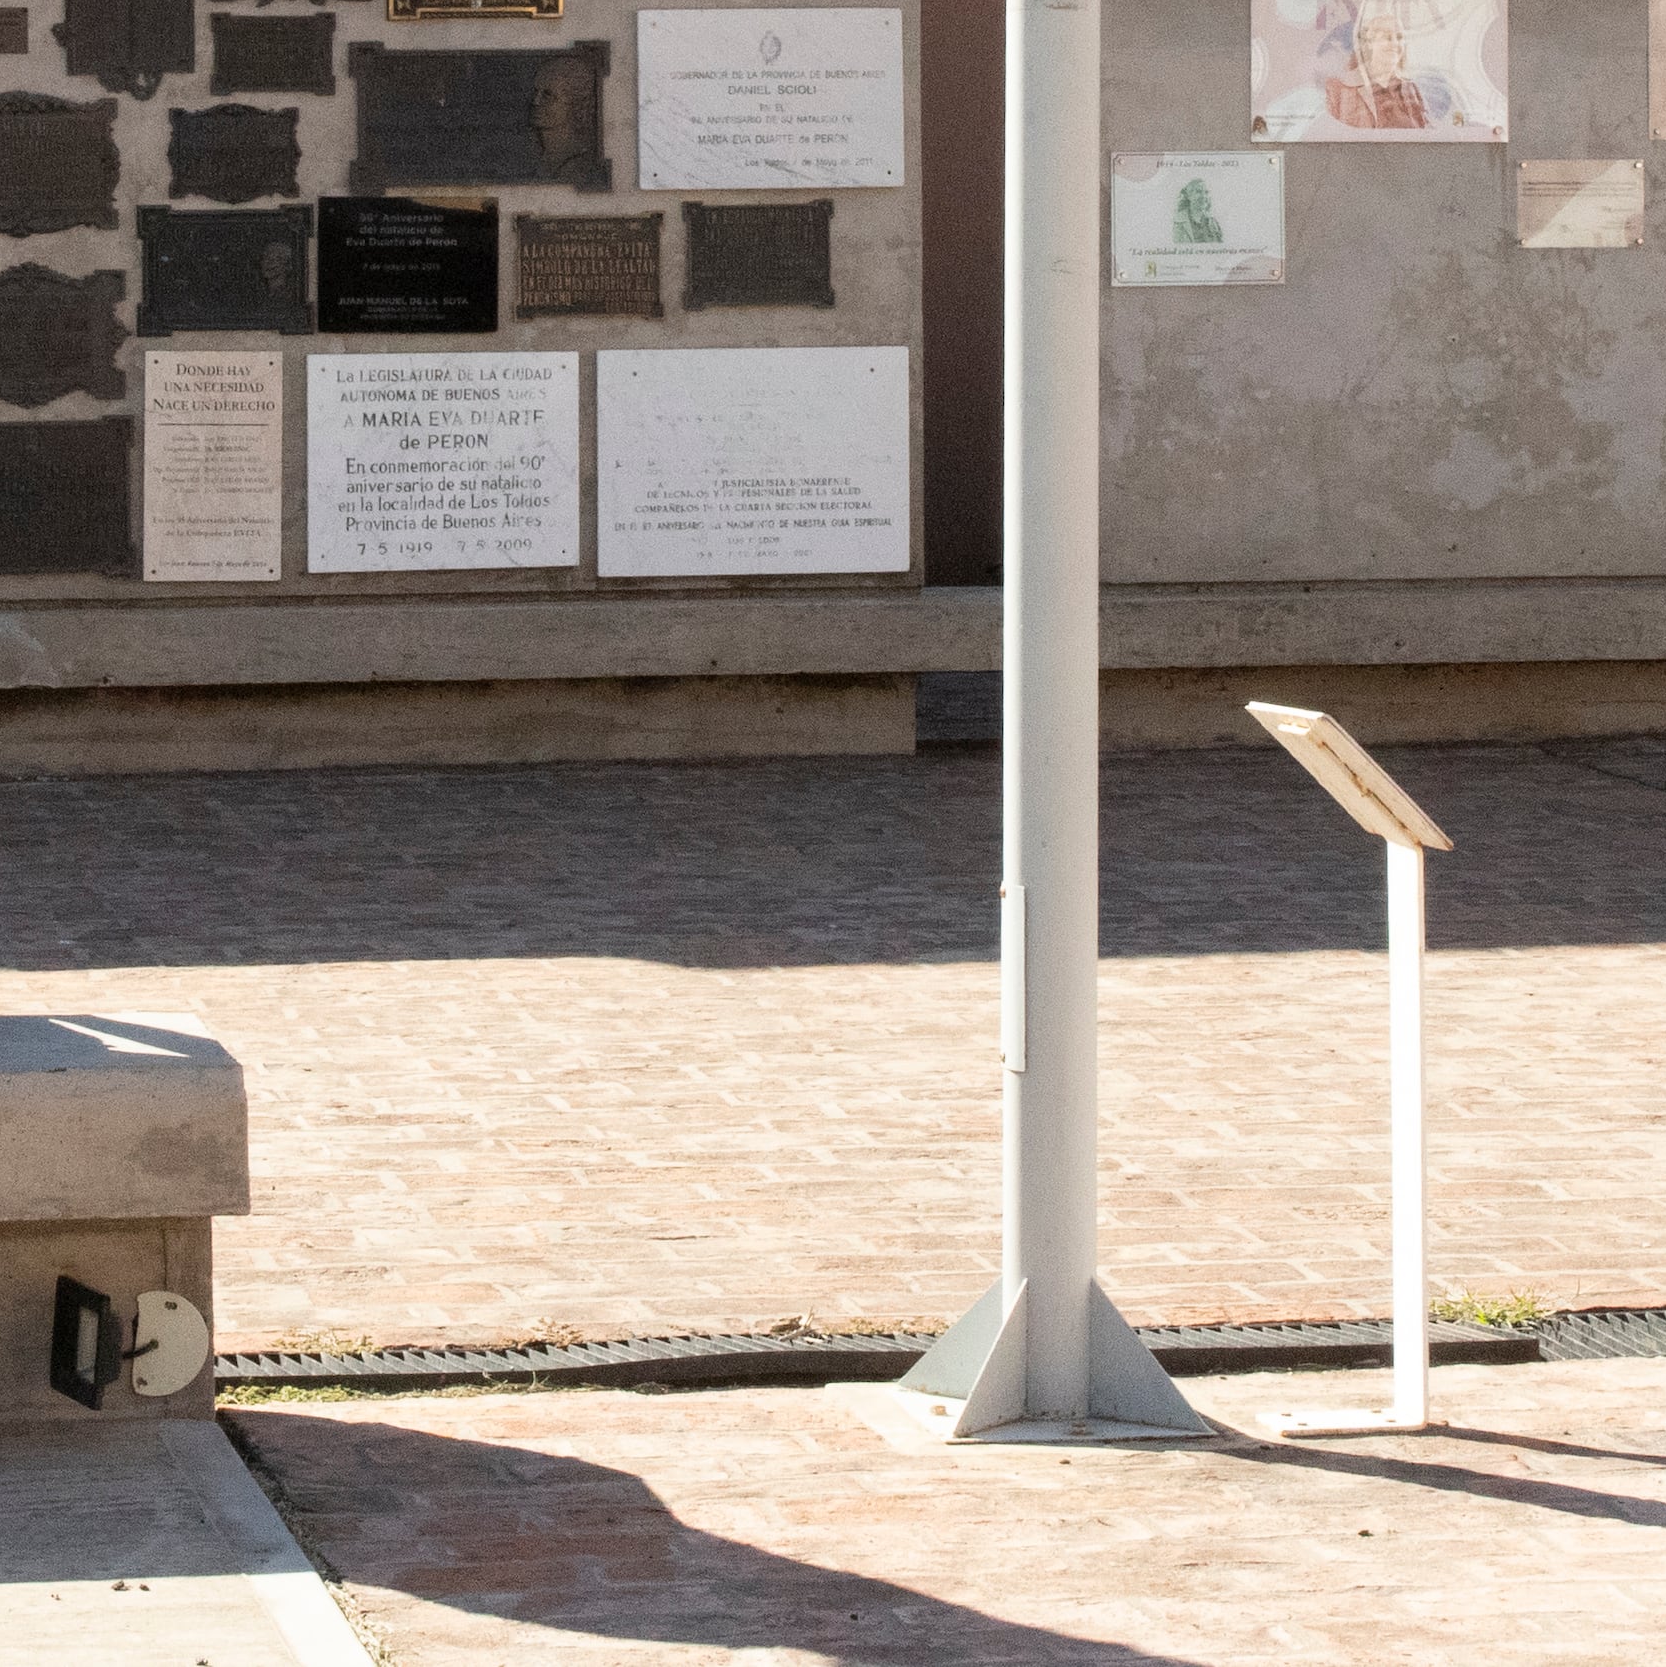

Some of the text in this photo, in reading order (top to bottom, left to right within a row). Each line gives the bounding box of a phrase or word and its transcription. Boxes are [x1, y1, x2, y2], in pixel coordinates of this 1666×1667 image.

[728, 85, 817, 95] DANIEL SCIOLI
[176, 364, 251, 377] DONDE HAY
[336, 367, 553, 383] La LEGISLATURA DE LA CIUDAD
[164, 382, 265, 393] UNA NECESIDAD
[340, 389, 417, 403] AUTONOMA
[422, 389, 439, 401] DE
[445, 388, 501, 402] BUENOS
[153, 398, 276, 412] NACE UN DERECHO
[343, 414, 355, 429] A
[362, 411, 422, 428] MARIA
[428, 411, 464, 427] EVA
[399, 433, 489, 450] de PERON
[346, 458, 366, 475] En
[369, 458, 487, 474] conmemoración
[493, 457, 516, 471] del
[346, 475, 542, 494] aniversario de su natalicio
[338, 492, 551, 513] en la localidad de Los Toldos
[346, 513, 543, 532] Provincia de Buenos Aires
[357, 538, 533, 556] 7 5 1919 7 5 2009
